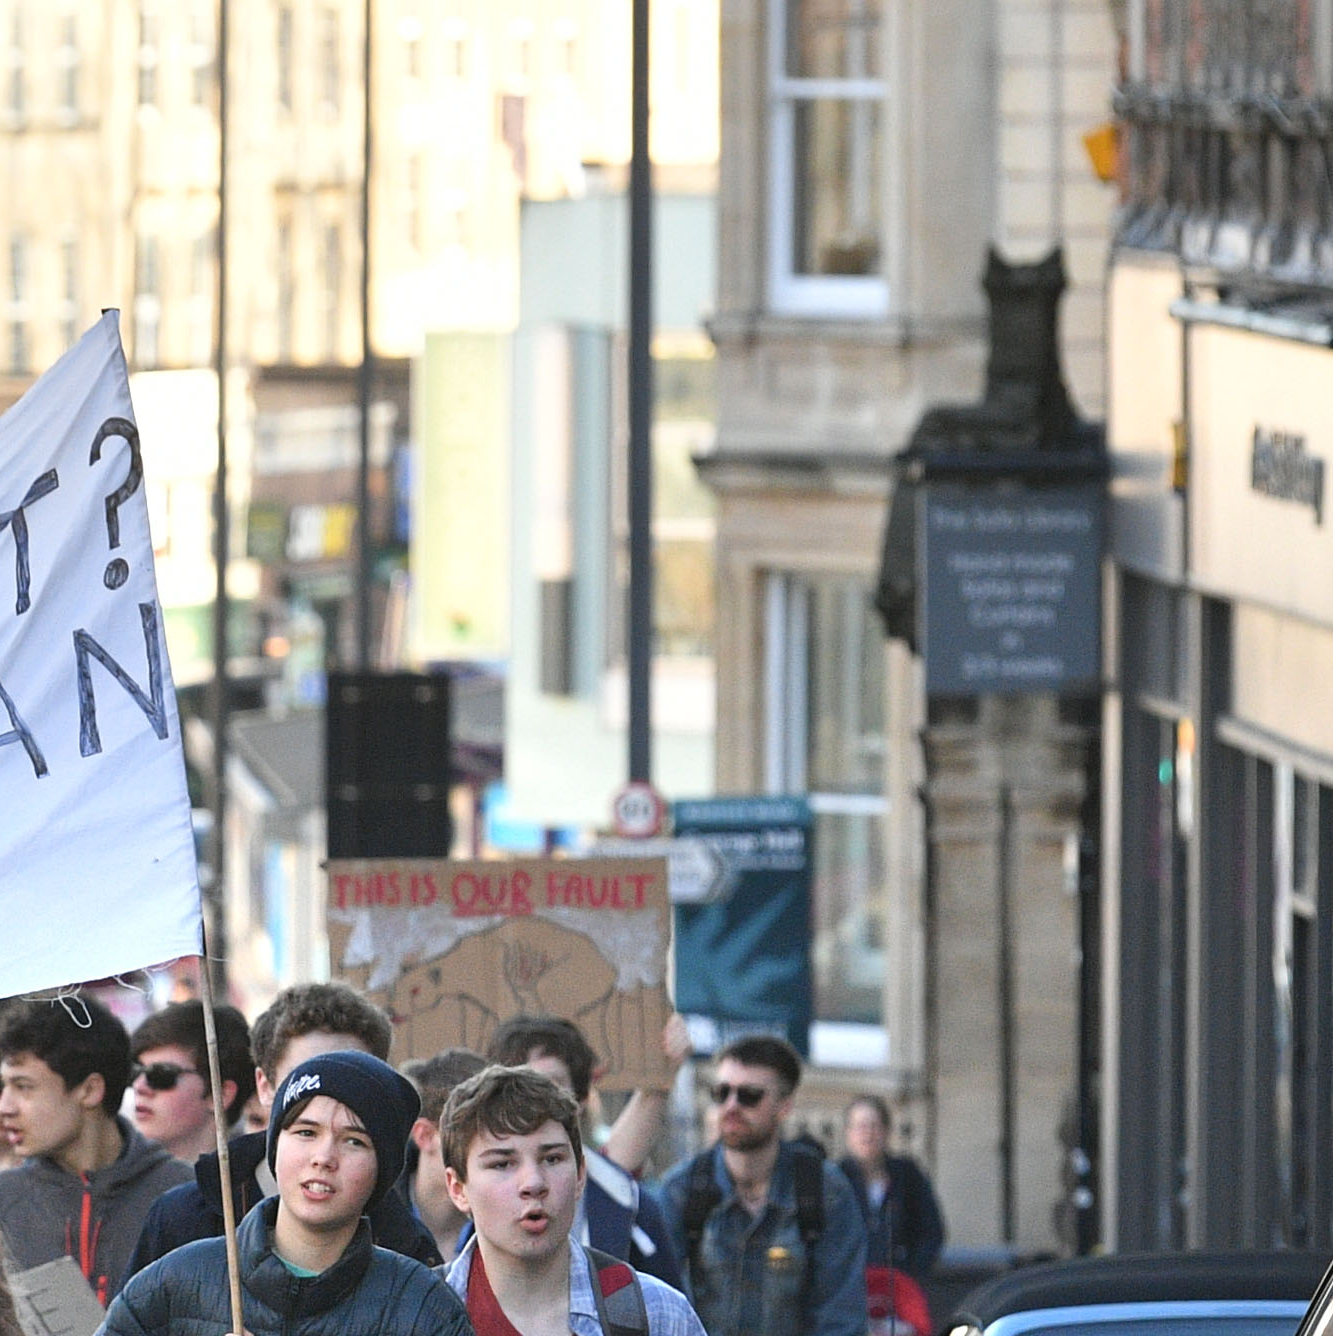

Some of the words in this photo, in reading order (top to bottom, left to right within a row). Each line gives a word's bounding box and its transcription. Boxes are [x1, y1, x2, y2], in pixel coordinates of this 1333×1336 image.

[333, 871, 402, 910] THIS
[409, 871, 437, 906] IS
[451, 869, 533, 912] OUR
[547, 871, 656, 909] FAULT
